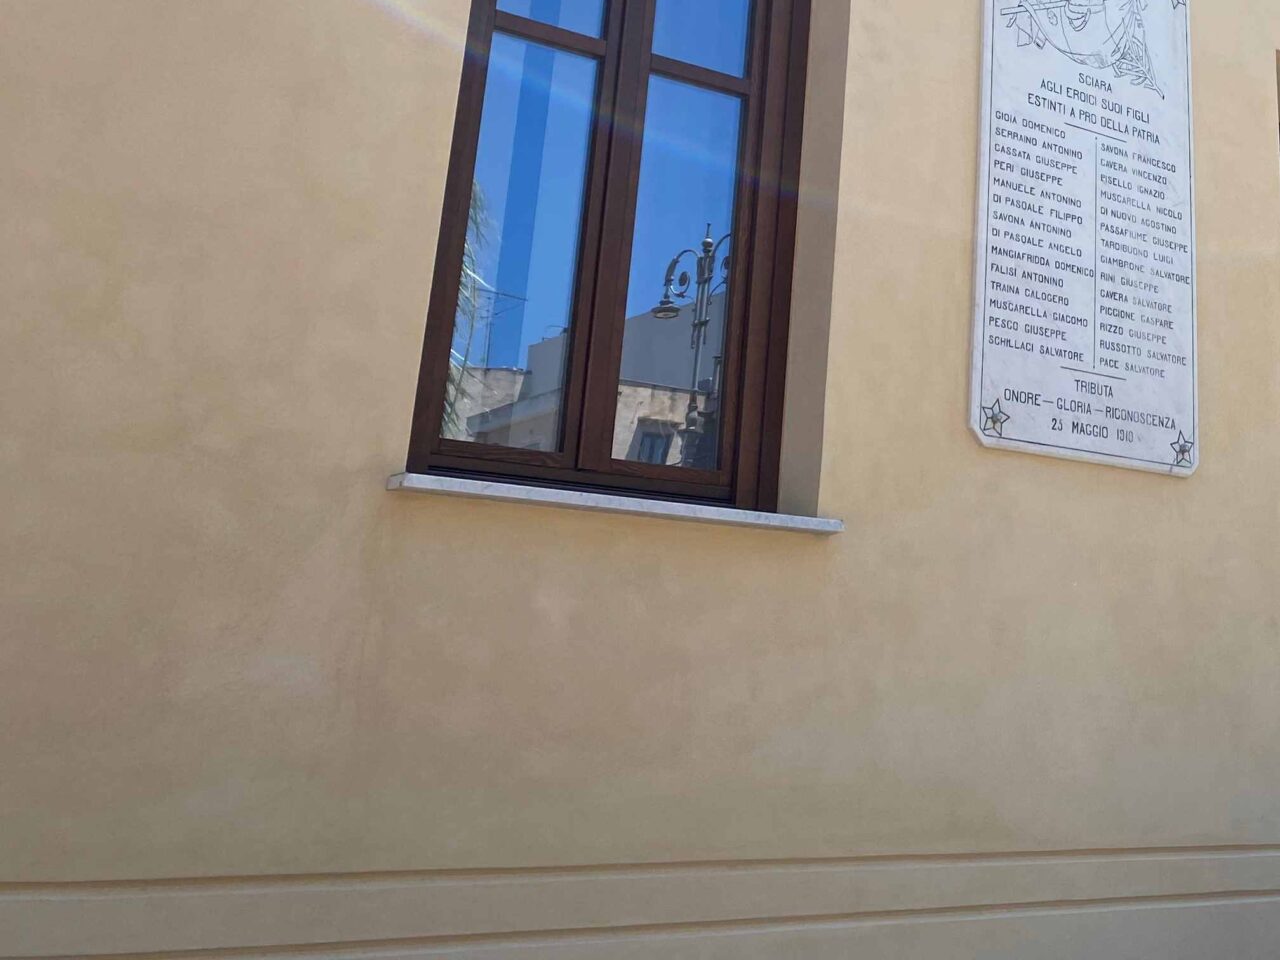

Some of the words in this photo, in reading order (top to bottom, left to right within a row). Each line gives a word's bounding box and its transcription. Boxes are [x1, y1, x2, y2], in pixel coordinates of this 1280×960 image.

[1079, 72, 1112, 93] SCIARA
[1040, 77, 1062, 95] AGLI
[1066, 87, 1097, 106] EROICI
[1101, 98, 1122, 115] SUOI
[1126, 107, 1149, 124] FIGLI
[995, 110, 1017, 124] GIOIA
[1022, 118, 1066, 139] DOMENICO
[1028, 92, 1065, 115] ESTINTI
[1070, 107, 1076, 118] A
[1079, 109, 1097, 125] PRO
[1100, 116, 1129, 135] DELLA
[1132, 126, 1160, 145] PATRIA
[995, 127, 1037, 146] SERRAINO
[1042, 141, 1083, 160] ANTONINO
[994, 143, 1031, 160] CASSATA
[1036, 155, 1078, 174] GIUSEPPE
[1101, 143, 1128, 159] SAVONA
[1133, 152, 1176, 173] FRANCESCO
[1101, 158, 1128, 174] CAVERA
[1132, 168, 1167, 185] VINCENZO
[994, 159, 1014, 172] PERI
[1021, 167, 1063, 186] GIUSEPPE
[994, 177, 1036, 196] MANUELE
[1040, 190, 1082, 208] ANTONINO
[1101, 190, 1151, 212] MUSCARELLA
[1137, 185, 1165, 200] IGNAZIO
[993, 194, 1001, 203] DI
[1050, 208, 1083, 225] FILIPPO
[1100, 206, 1108, 216] DI
[1111, 209, 1136, 223] NUOVO
[1141, 218, 1177, 234] AGOSTINO
[993, 210, 1025, 226] SAVONA
[1029, 220, 1072, 238] ANTONINO
[1100, 222, 1147, 242] PASSAFIUME
[1152, 237, 1188, 253] GIUSEPPE
[992, 228, 1000, 237] DI
[1048, 242, 1082, 257] ANGELO
[991, 245, 1050, 267] MANGIAFRIDDA
[1055, 261, 1094, 278] DOMENICO
[1153, 252, 1174, 265] LUIGI
[991, 263, 1017, 277] FALISI
[1021, 270, 1064, 288] ANTONINO
[1100, 272, 1115, 283] RINI
[1120, 277, 1159, 294] GIUSEPPE
[1150, 268, 1190, 285] SALVATORE
[991, 281, 1020, 295] TRAINA
[1025, 288, 1069, 306] CALOGERO
[1100, 289, 1128, 303] CAVERA
[1133, 297, 1172, 314] SALVATORE
[990, 298, 1048, 319] MUSCARELLA
[1053, 312, 1088, 328] GIACOMO
[1100, 305, 1136, 321] PICCIONE
[1141, 314, 1174, 330] GASPARE
[989, 316, 1019, 331] PESCO
[1025, 323, 1067, 341] GIUSEPPE
[1100, 322, 1124, 336] RIZZO
[1129, 329, 1167, 345] GIUSEPPE
[989, 335, 1034, 352] SCHILLACI
[1040, 345, 1084, 362] SALVATORE
[1100, 340, 1142, 357] RUSSOTTO
[1147, 350, 1187, 366] SALVATORE
[1100, 357, 1119, 369] PACE
[1125, 362, 1165, 378] SALVATORE
[1074, 379, 1114, 398] TRIBUTA
[1004, 388, 1041, 406] ONORE
[1056, 398, 1092, 415] GLORIA
[1105, 406, 1176, 431] RICONOSCENZA
[1072, 421, 1109, 439] MAGGIO
